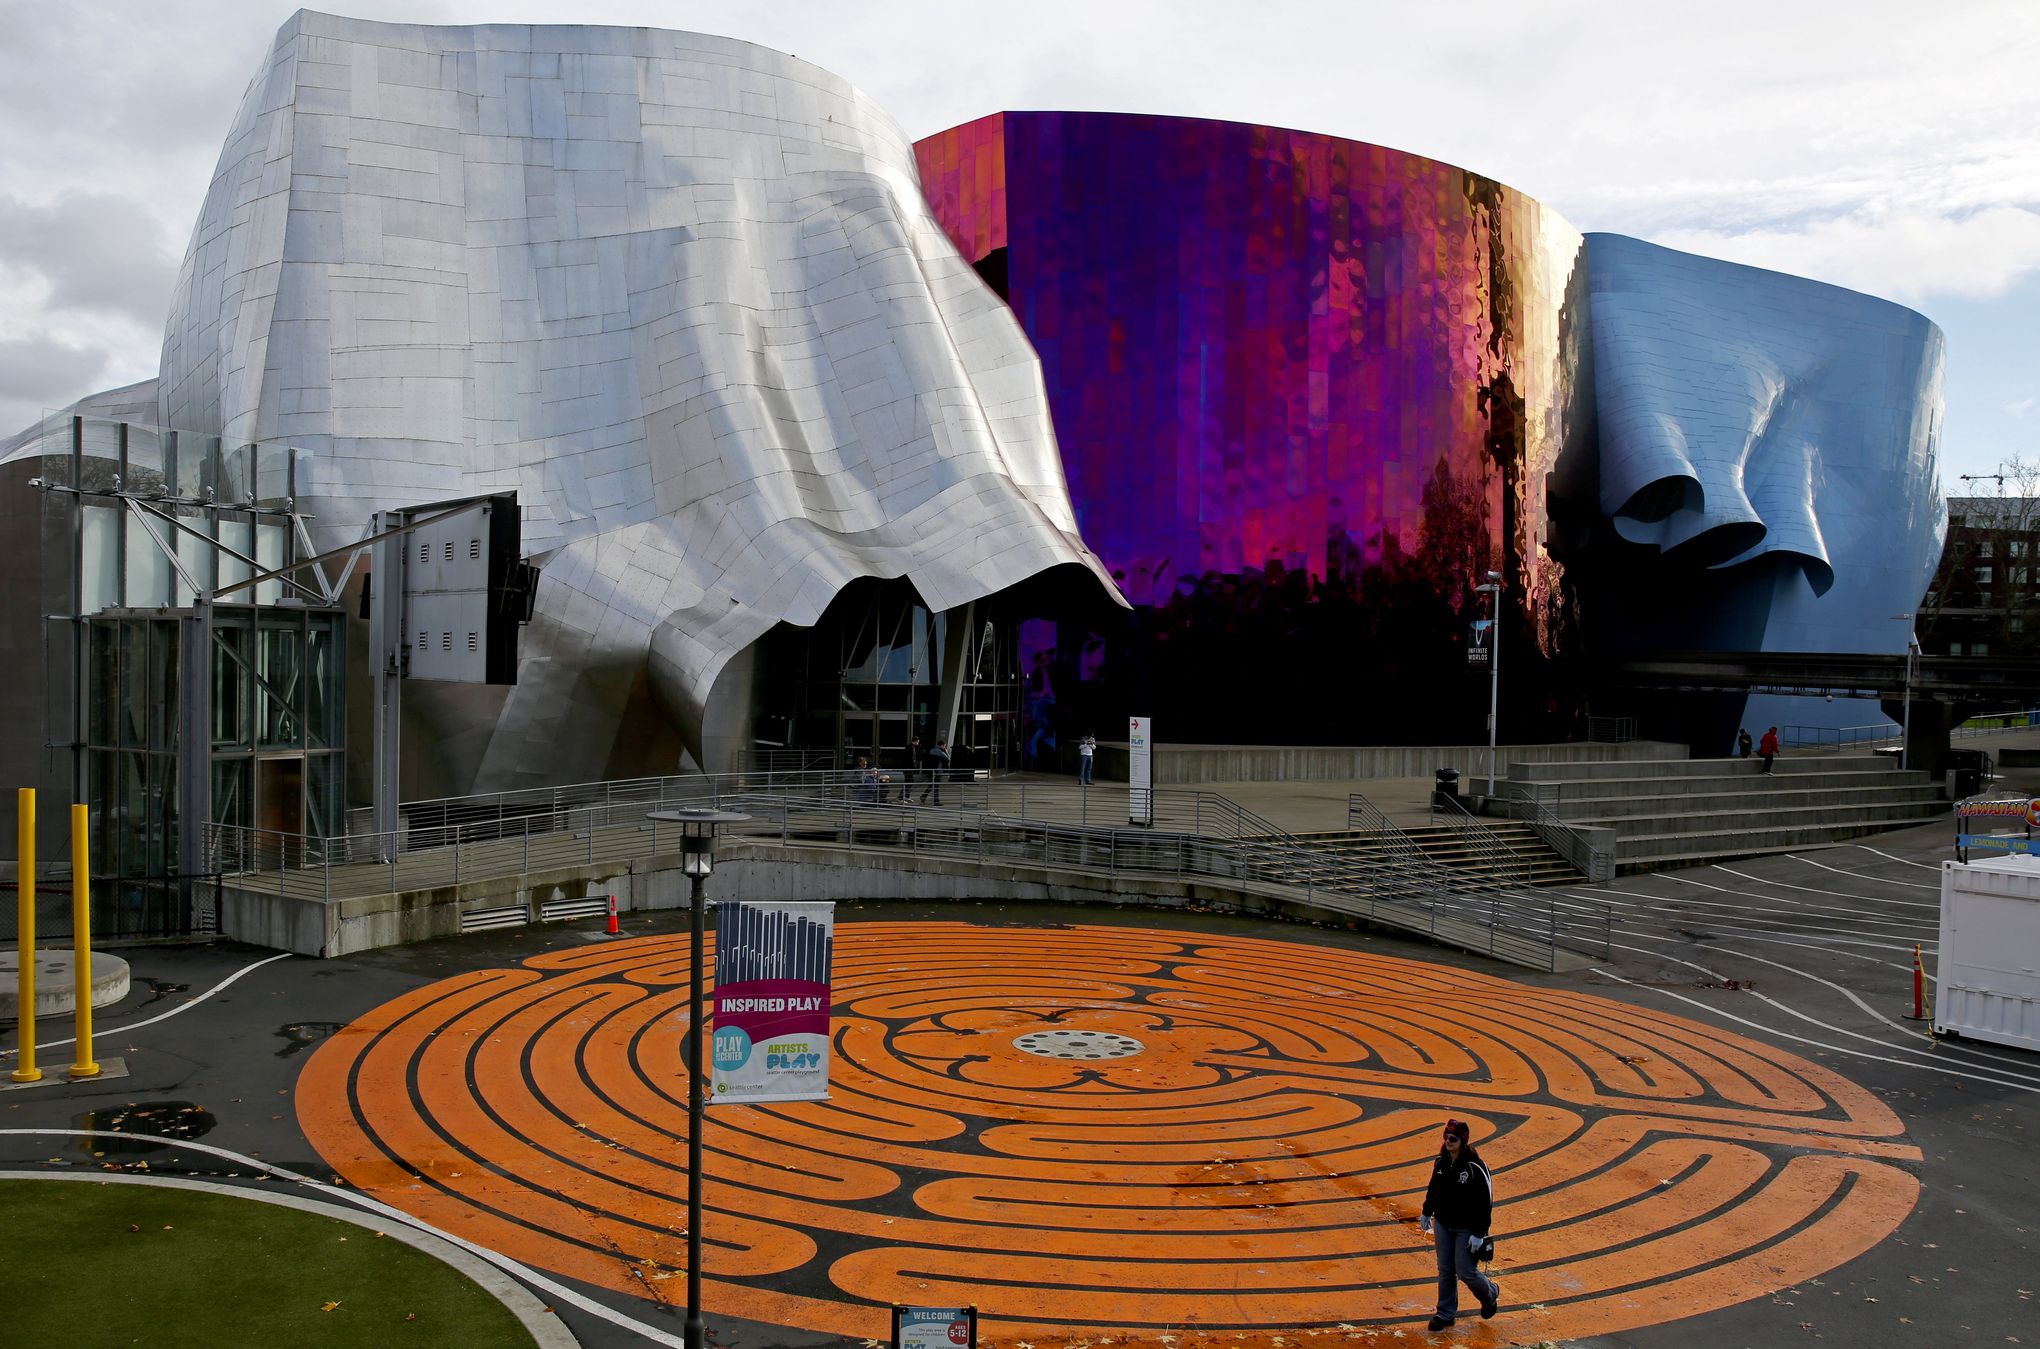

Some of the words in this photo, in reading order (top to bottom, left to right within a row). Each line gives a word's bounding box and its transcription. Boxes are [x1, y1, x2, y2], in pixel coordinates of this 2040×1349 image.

[1958, 803, 2028, 817] HAWAIIAN
[1970, 838, 2009, 849] LEMONADE
[2013, 842, 2029, 851] AND
[721, 998, 785, 1013] INSPIRED
[787, 997, 822, 1012] PLAY
[716, 1036, 742, 1052] PLAY
[768, 1043, 808, 1054] ARTISTS
[720, 1052, 742, 1061] CENTER
[766, 1053, 820, 1069] PLAY
[913, 1312, 955, 1320] WELCOME
[949, 1329, 967, 1337] 5-12
